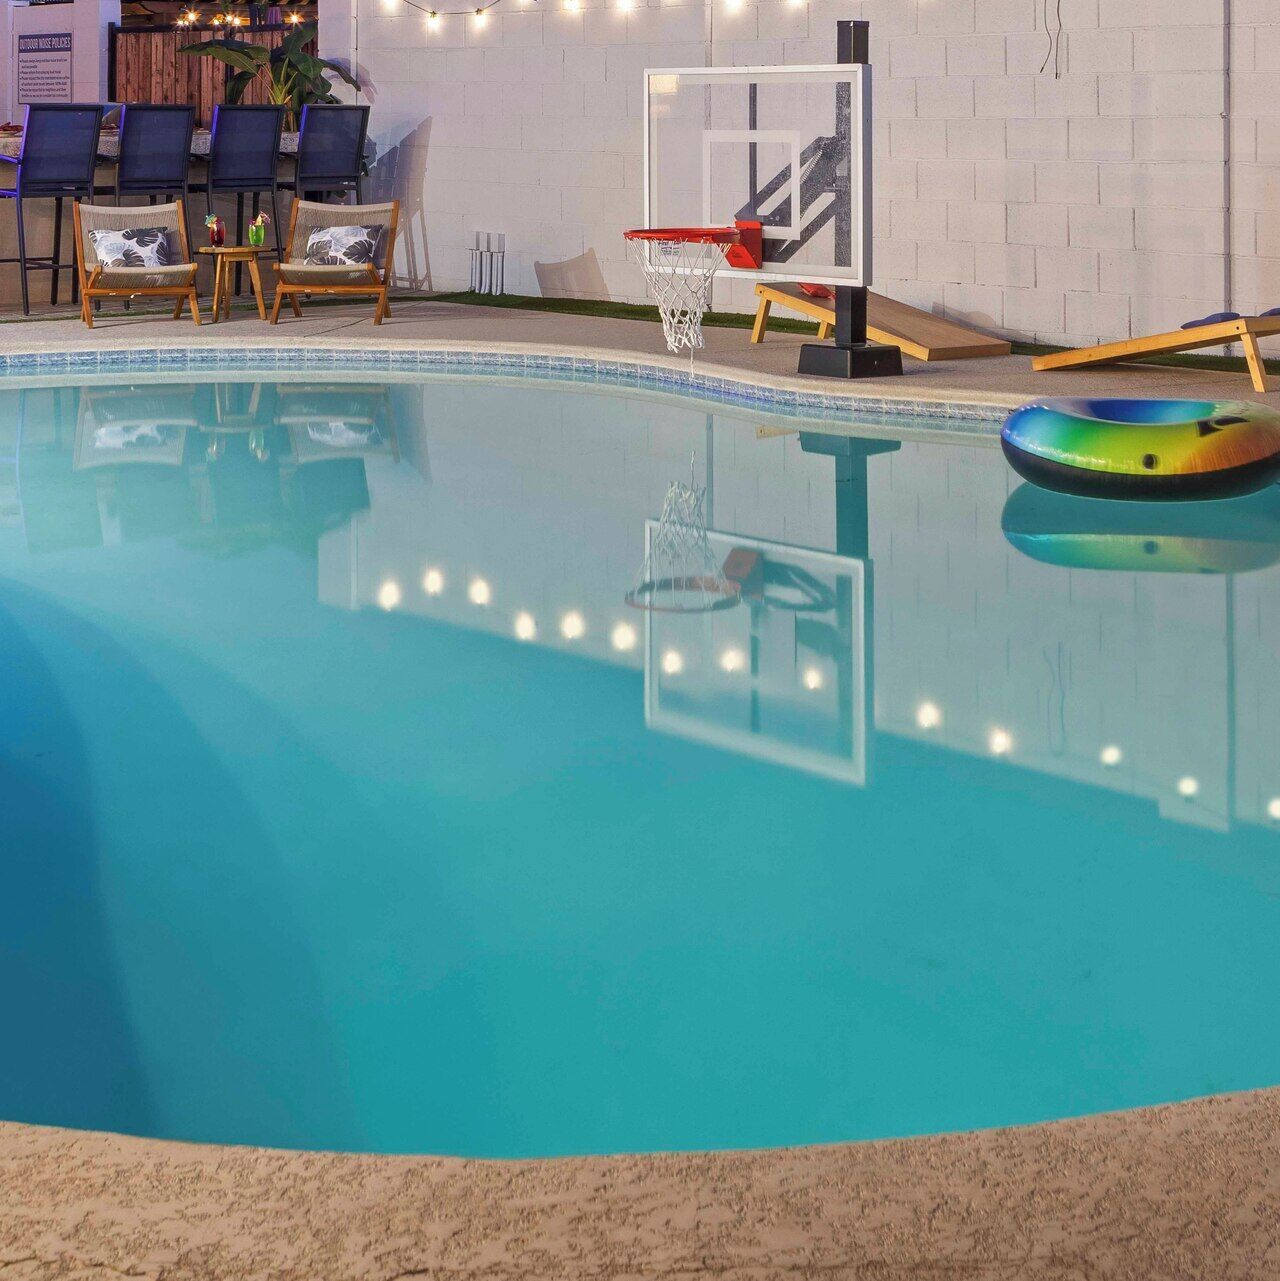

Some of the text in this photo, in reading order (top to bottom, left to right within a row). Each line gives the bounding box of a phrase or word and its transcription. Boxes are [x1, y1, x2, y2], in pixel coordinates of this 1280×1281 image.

[20, 37, 71, 49] OUTDOOR NOISE POLICIES
